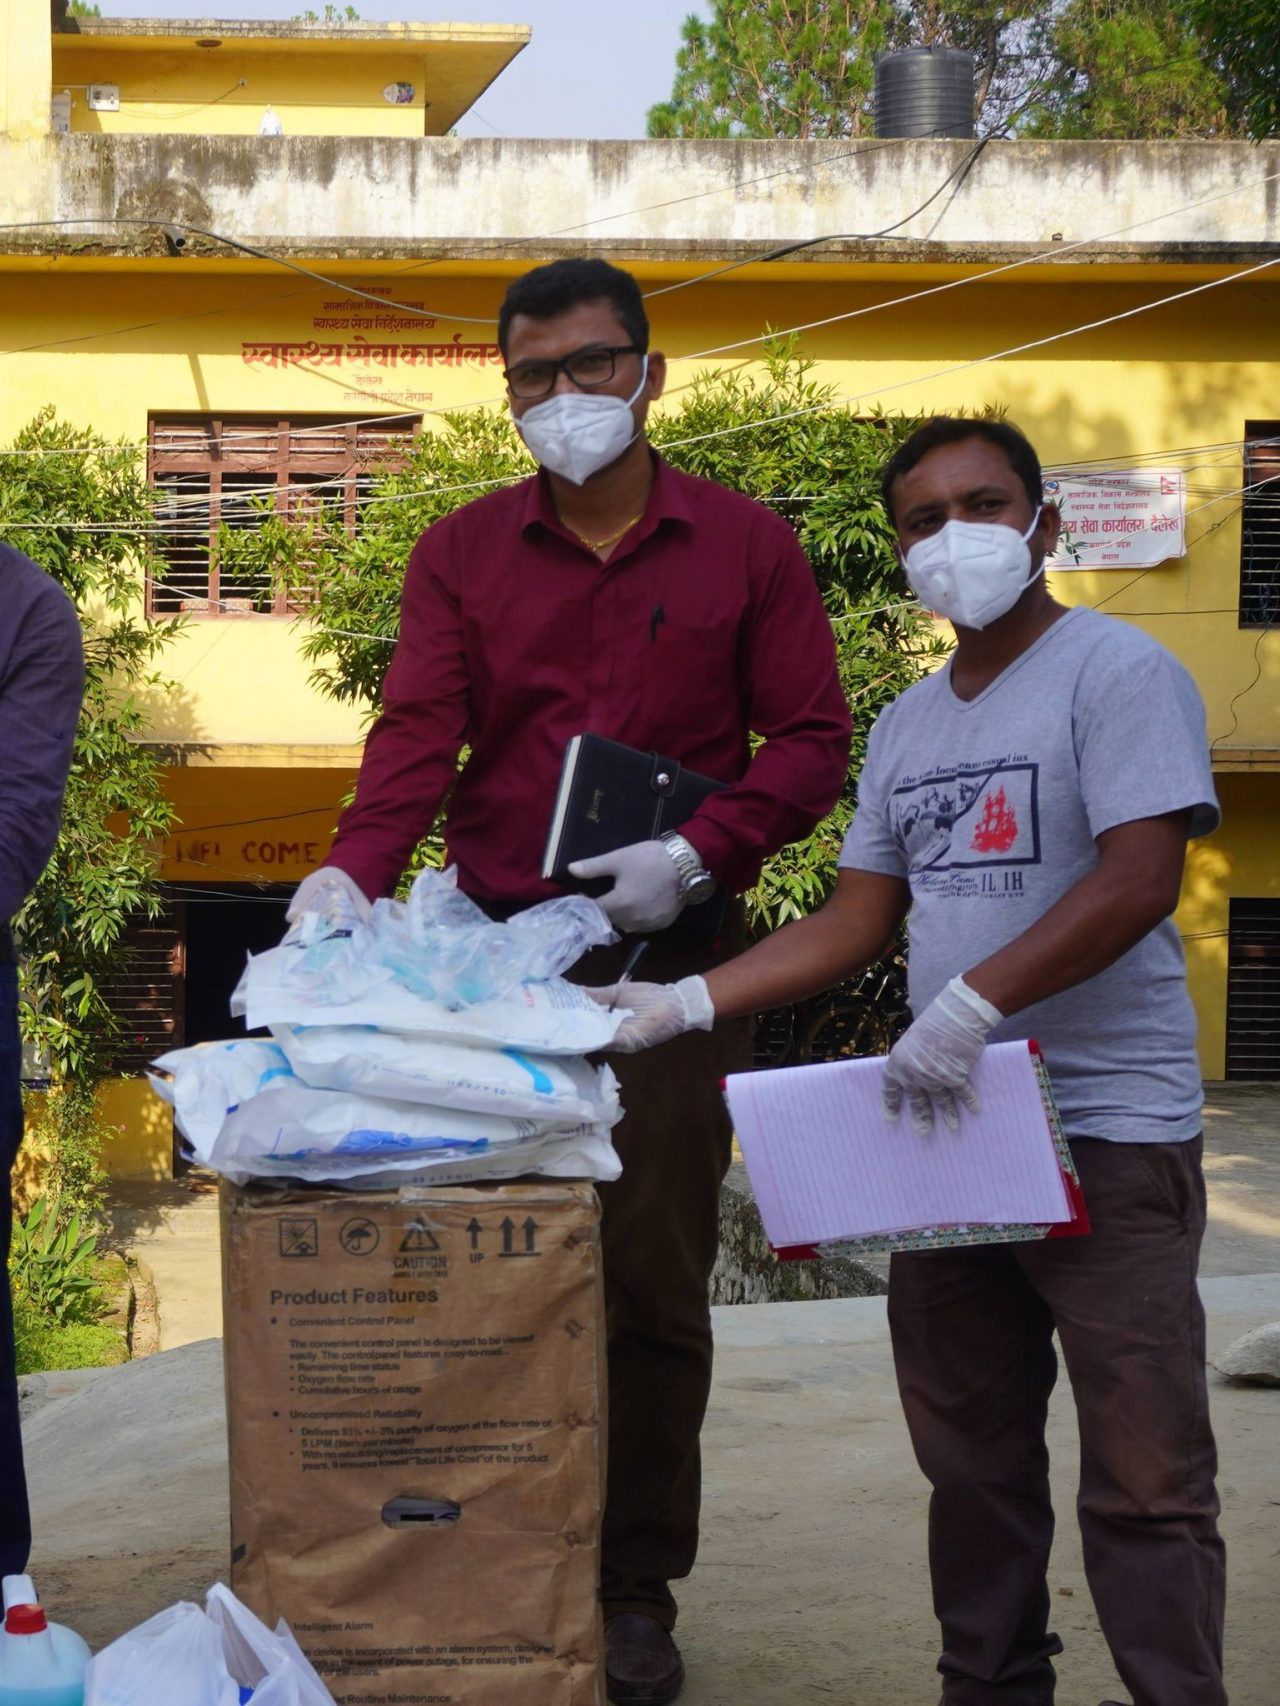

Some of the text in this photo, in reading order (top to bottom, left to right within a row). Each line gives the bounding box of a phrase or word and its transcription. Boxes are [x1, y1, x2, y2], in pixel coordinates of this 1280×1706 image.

[351, 314, 372, 330] सेवा
[346, 335, 400, 369] सेवा
[405, 389, 433, 402] नेपाल
[1081, 516, 1099, 535] सेवा
[1101, 552, 1120, 561] नेपाल
[241, 841, 320, 865] COME
[394, 1252, 485, 1269] CAUTION UP
[270, 1287, 438, 1305] Product Features
[289, 1315, 415, 1327] Convenient Control Panel
[290, 1333, 535, 1350] The convenient control panel is designed to be viewed
[322, 1350, 339, 1360] The
[403, 1349, 441, 1359] features
[298, 1362, 400, 1373] Remaining time status
[298, 1374, 376, 1385] Oxygen flow rate
[298, 1385, 422, 1395] Cumulative hours of usage
[289, 1408, 423, 1420] Uncompromised Reliability
[301, 1427, 340, 1436] Delivers
[396, 1425, 423, 1435] purity
[424, 1424, 434, 1433] of
[436, 1423, 470, 1434] oxygen
[472, 1421, 481, 1430] at
[482, 1420, 498, 1430] the
[499, 1419, 520, 1429] flow
[521, 1419, 541, 1429] rate
[542, 1419, 552, 1429] of
[302, 1439, 309, 1448] 5
[310, 1439, 333, 1448] LPM
[301, 1450, 322, 1459] With
[324, 1451, 337, 1459] no
[444, 1445, 454, 1454] of
[455, 1443, 509, 1455] compressor
[511, 1442, 524, 1452] for
[526, 1442, 533, 1451] 5
[340, 1460, 377, 1470] ensures
[378, 1458, 409, 1468] lowest
[438, 1455, 456, 1465] Life
[483, 1454, 494, 1463] of
[495, 1454, 511, 1463] the
[513, 1453, 549, 1465] product
[294, 1621, 374, 1633] Intelligent Alarm
[313, 1647, 343, 1657] device
[345, 1647, 353, 1656] is
[355, 1646, 413, 1657] incorporated
[415, 1645, 434, 1654] with
[435, 1646, 447, 1654] an
[449, 1644, 476, 1654] alarm
[514, 1644, 555, 1654] designed
[357, 1657, 383, 1667] event
[384, 1656, 395, 1666] of
[396, 1656, 425, 1668] power
[461, 1655, 475, 1665] for
[476, 1655, 517, 1667] ensuring
[517, 1654, 534, 1664] the
[346, 1694, 386, 1705] Routine
[387, 1693, 452, 1704] Maintenance
